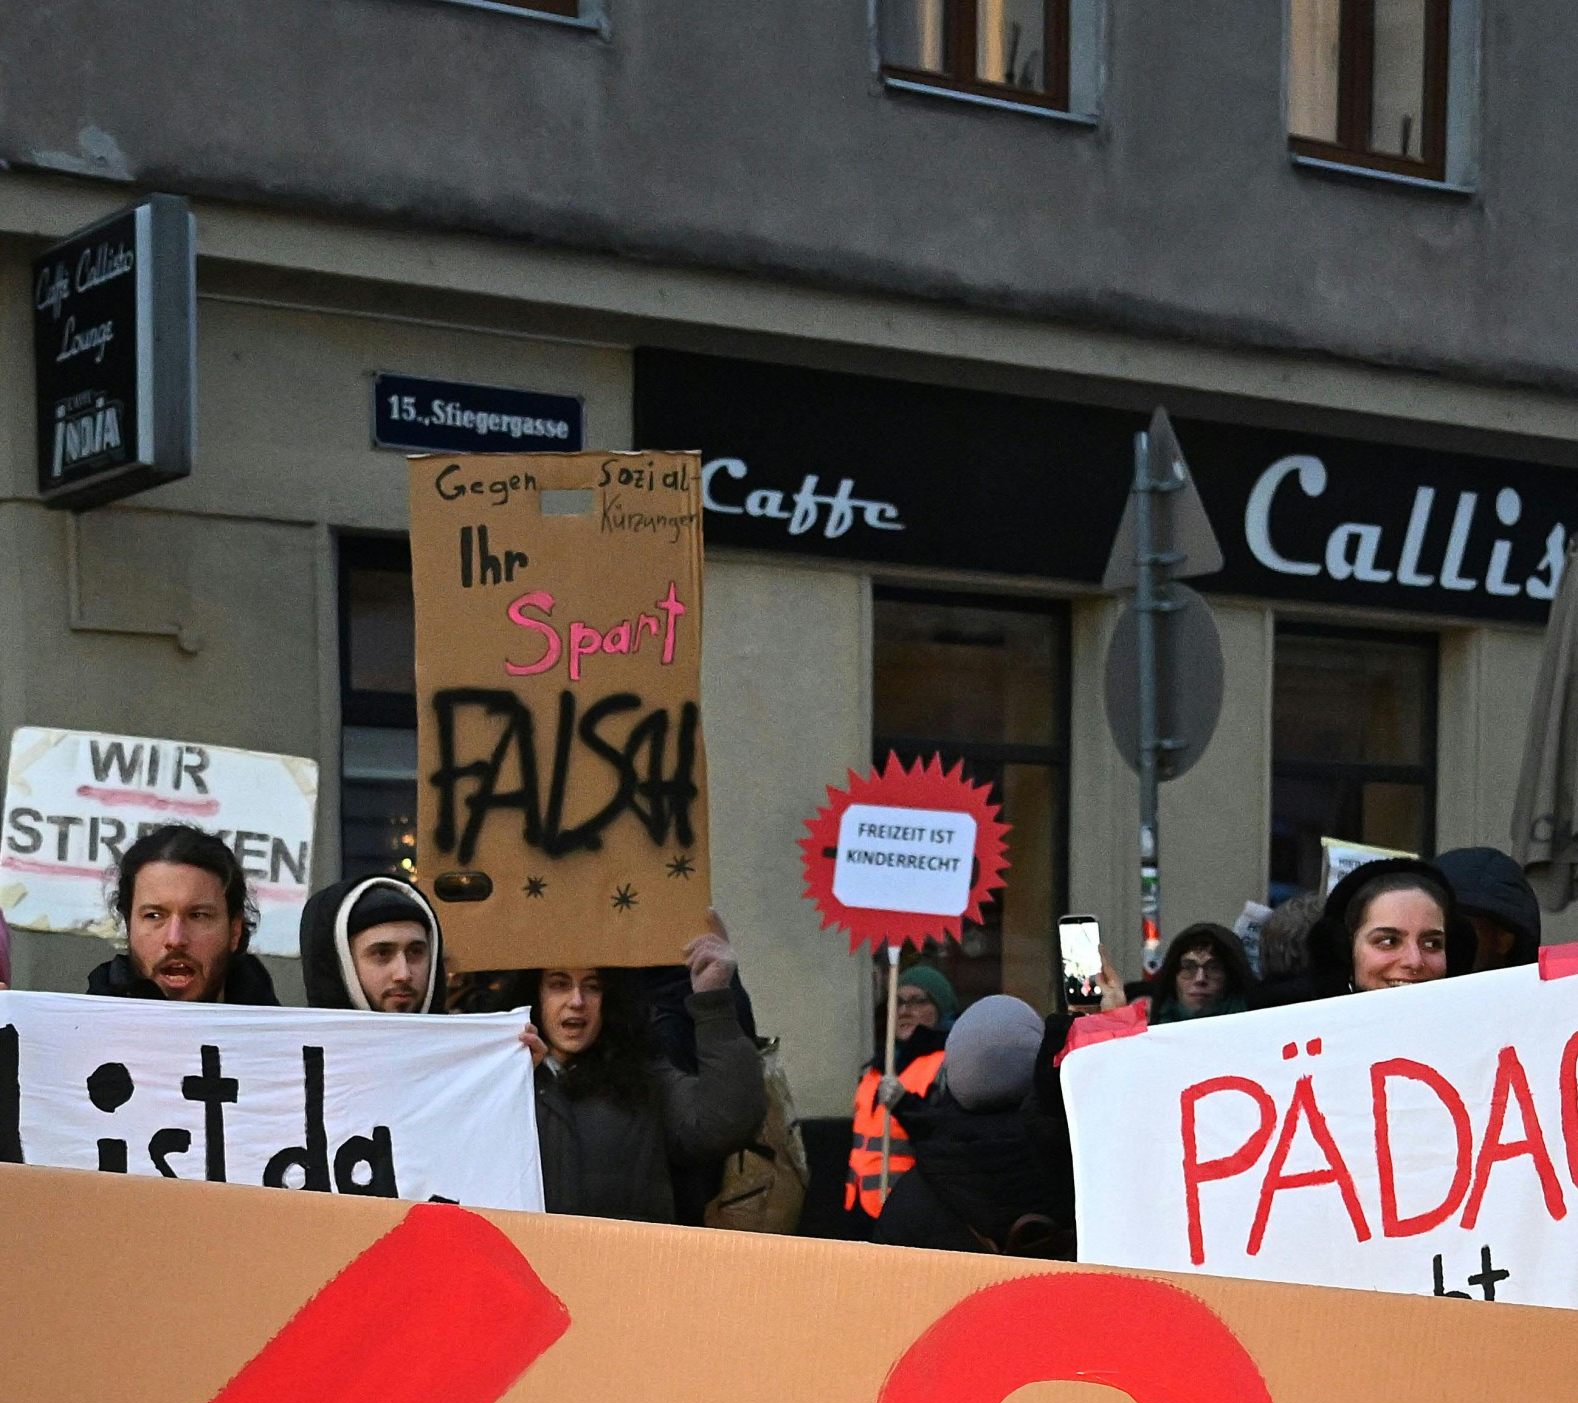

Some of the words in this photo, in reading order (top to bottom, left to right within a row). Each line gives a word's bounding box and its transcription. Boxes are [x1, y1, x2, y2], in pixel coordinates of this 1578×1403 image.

[56, 315, 114, 363] Lounge
[436, 464, 537, 506] Gegen
[461, 524, 530, 588] Ihr
[504, 581, 687, 681] Spart
[90, 739, 211, 794] WIR
[858, 822, 926, 842] FREIZEIT
[930, 829, 955, 844] IST
[847, 849, 961, 873] KINDERRECHT
